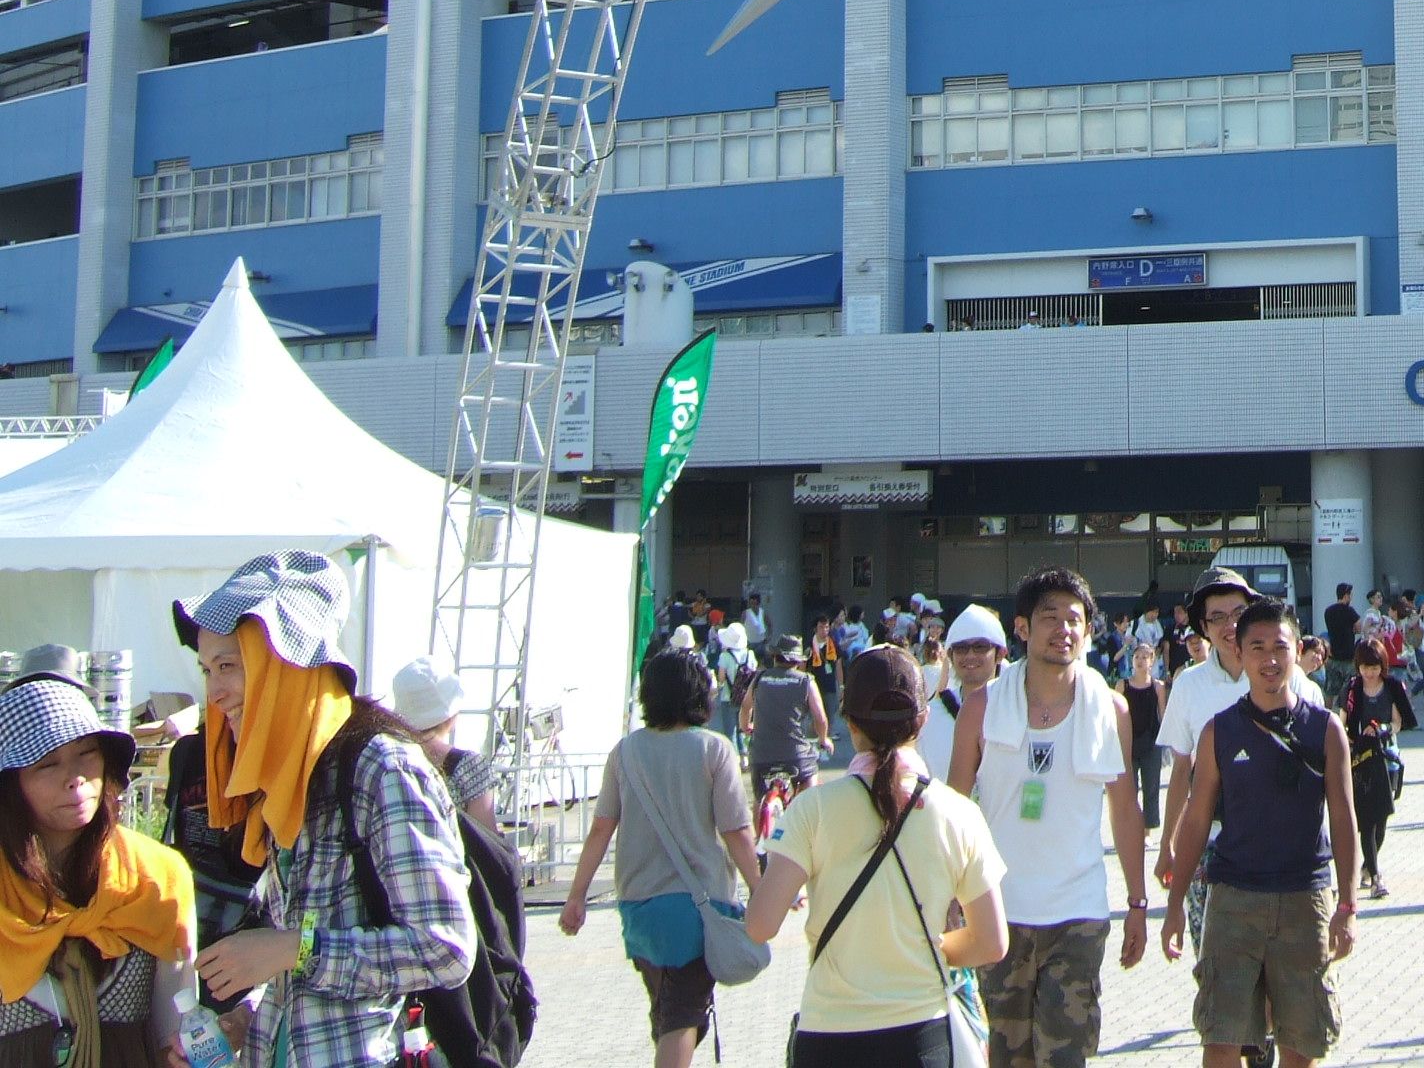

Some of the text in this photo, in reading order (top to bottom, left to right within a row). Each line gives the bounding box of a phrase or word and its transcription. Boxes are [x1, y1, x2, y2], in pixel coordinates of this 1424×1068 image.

[700, 260, 746, 283] STADIUM
[1140, 259, 1153, 277] D
[191, 1037, 215, 1051] Pure
